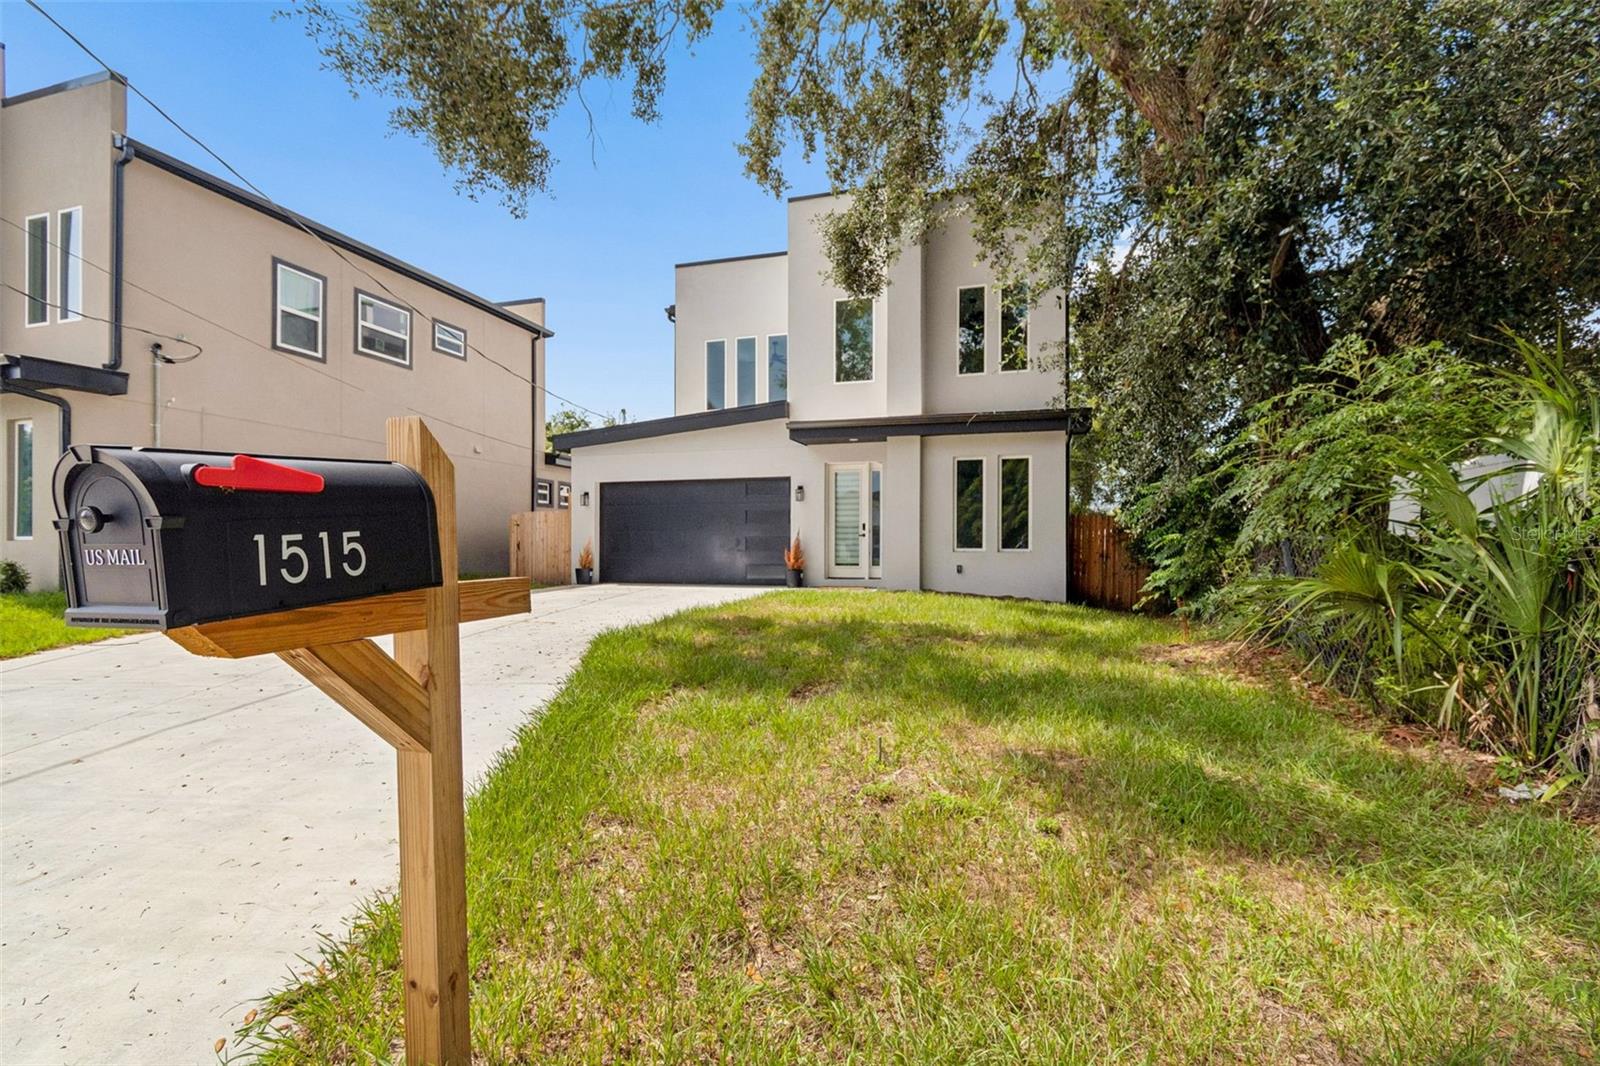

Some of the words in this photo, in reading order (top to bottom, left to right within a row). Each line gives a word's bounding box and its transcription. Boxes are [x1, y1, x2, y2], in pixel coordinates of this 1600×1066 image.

[84, 549, 104, 566] US
[106, 549, 145, 566] MAIL
[253, 530, 367, 586] 1515
